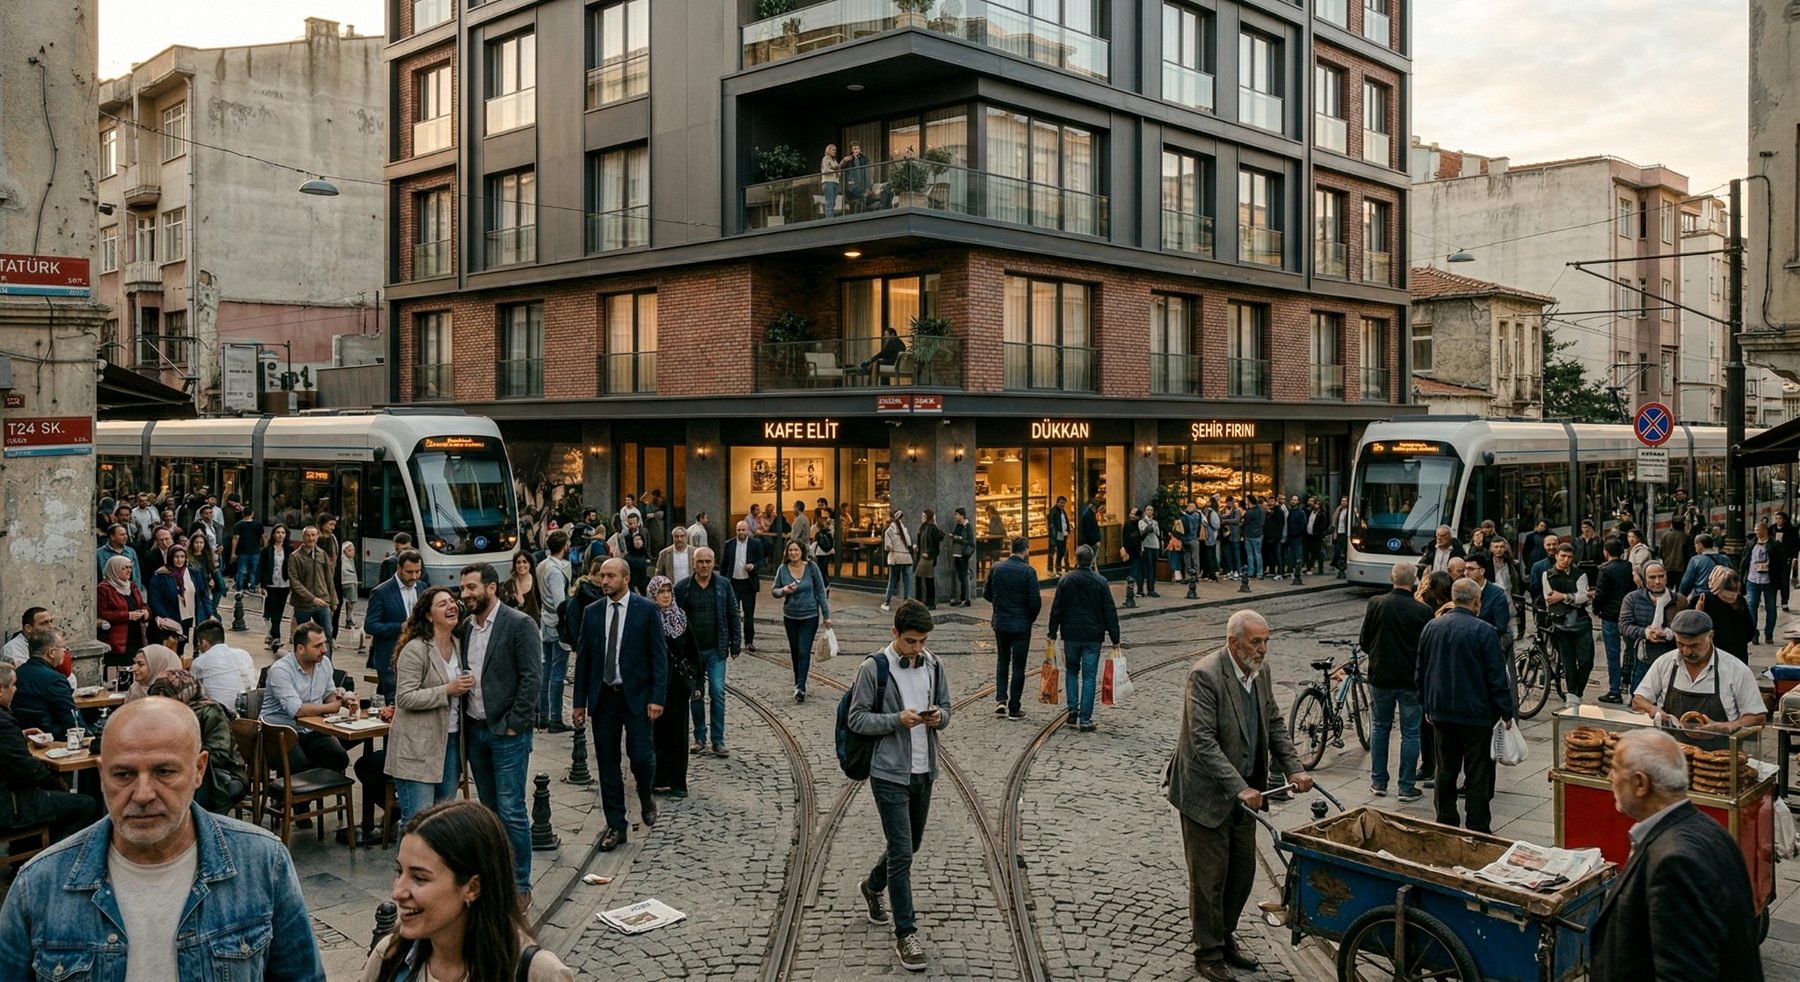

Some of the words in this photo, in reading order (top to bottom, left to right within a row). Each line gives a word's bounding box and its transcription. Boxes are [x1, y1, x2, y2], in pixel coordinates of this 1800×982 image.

[7, 421, 36, 436] T24
[41, 421, 66, 435] SK.
[764, 422, 803, 439] KAFE
[807, 418, 839, 439] ELİT
[1031, 418, 1089, 439] DÜKKAN
[1191, 420, 1223, 441] ŞEHİR
[1225, 423, 1255, 438] FIRINI
